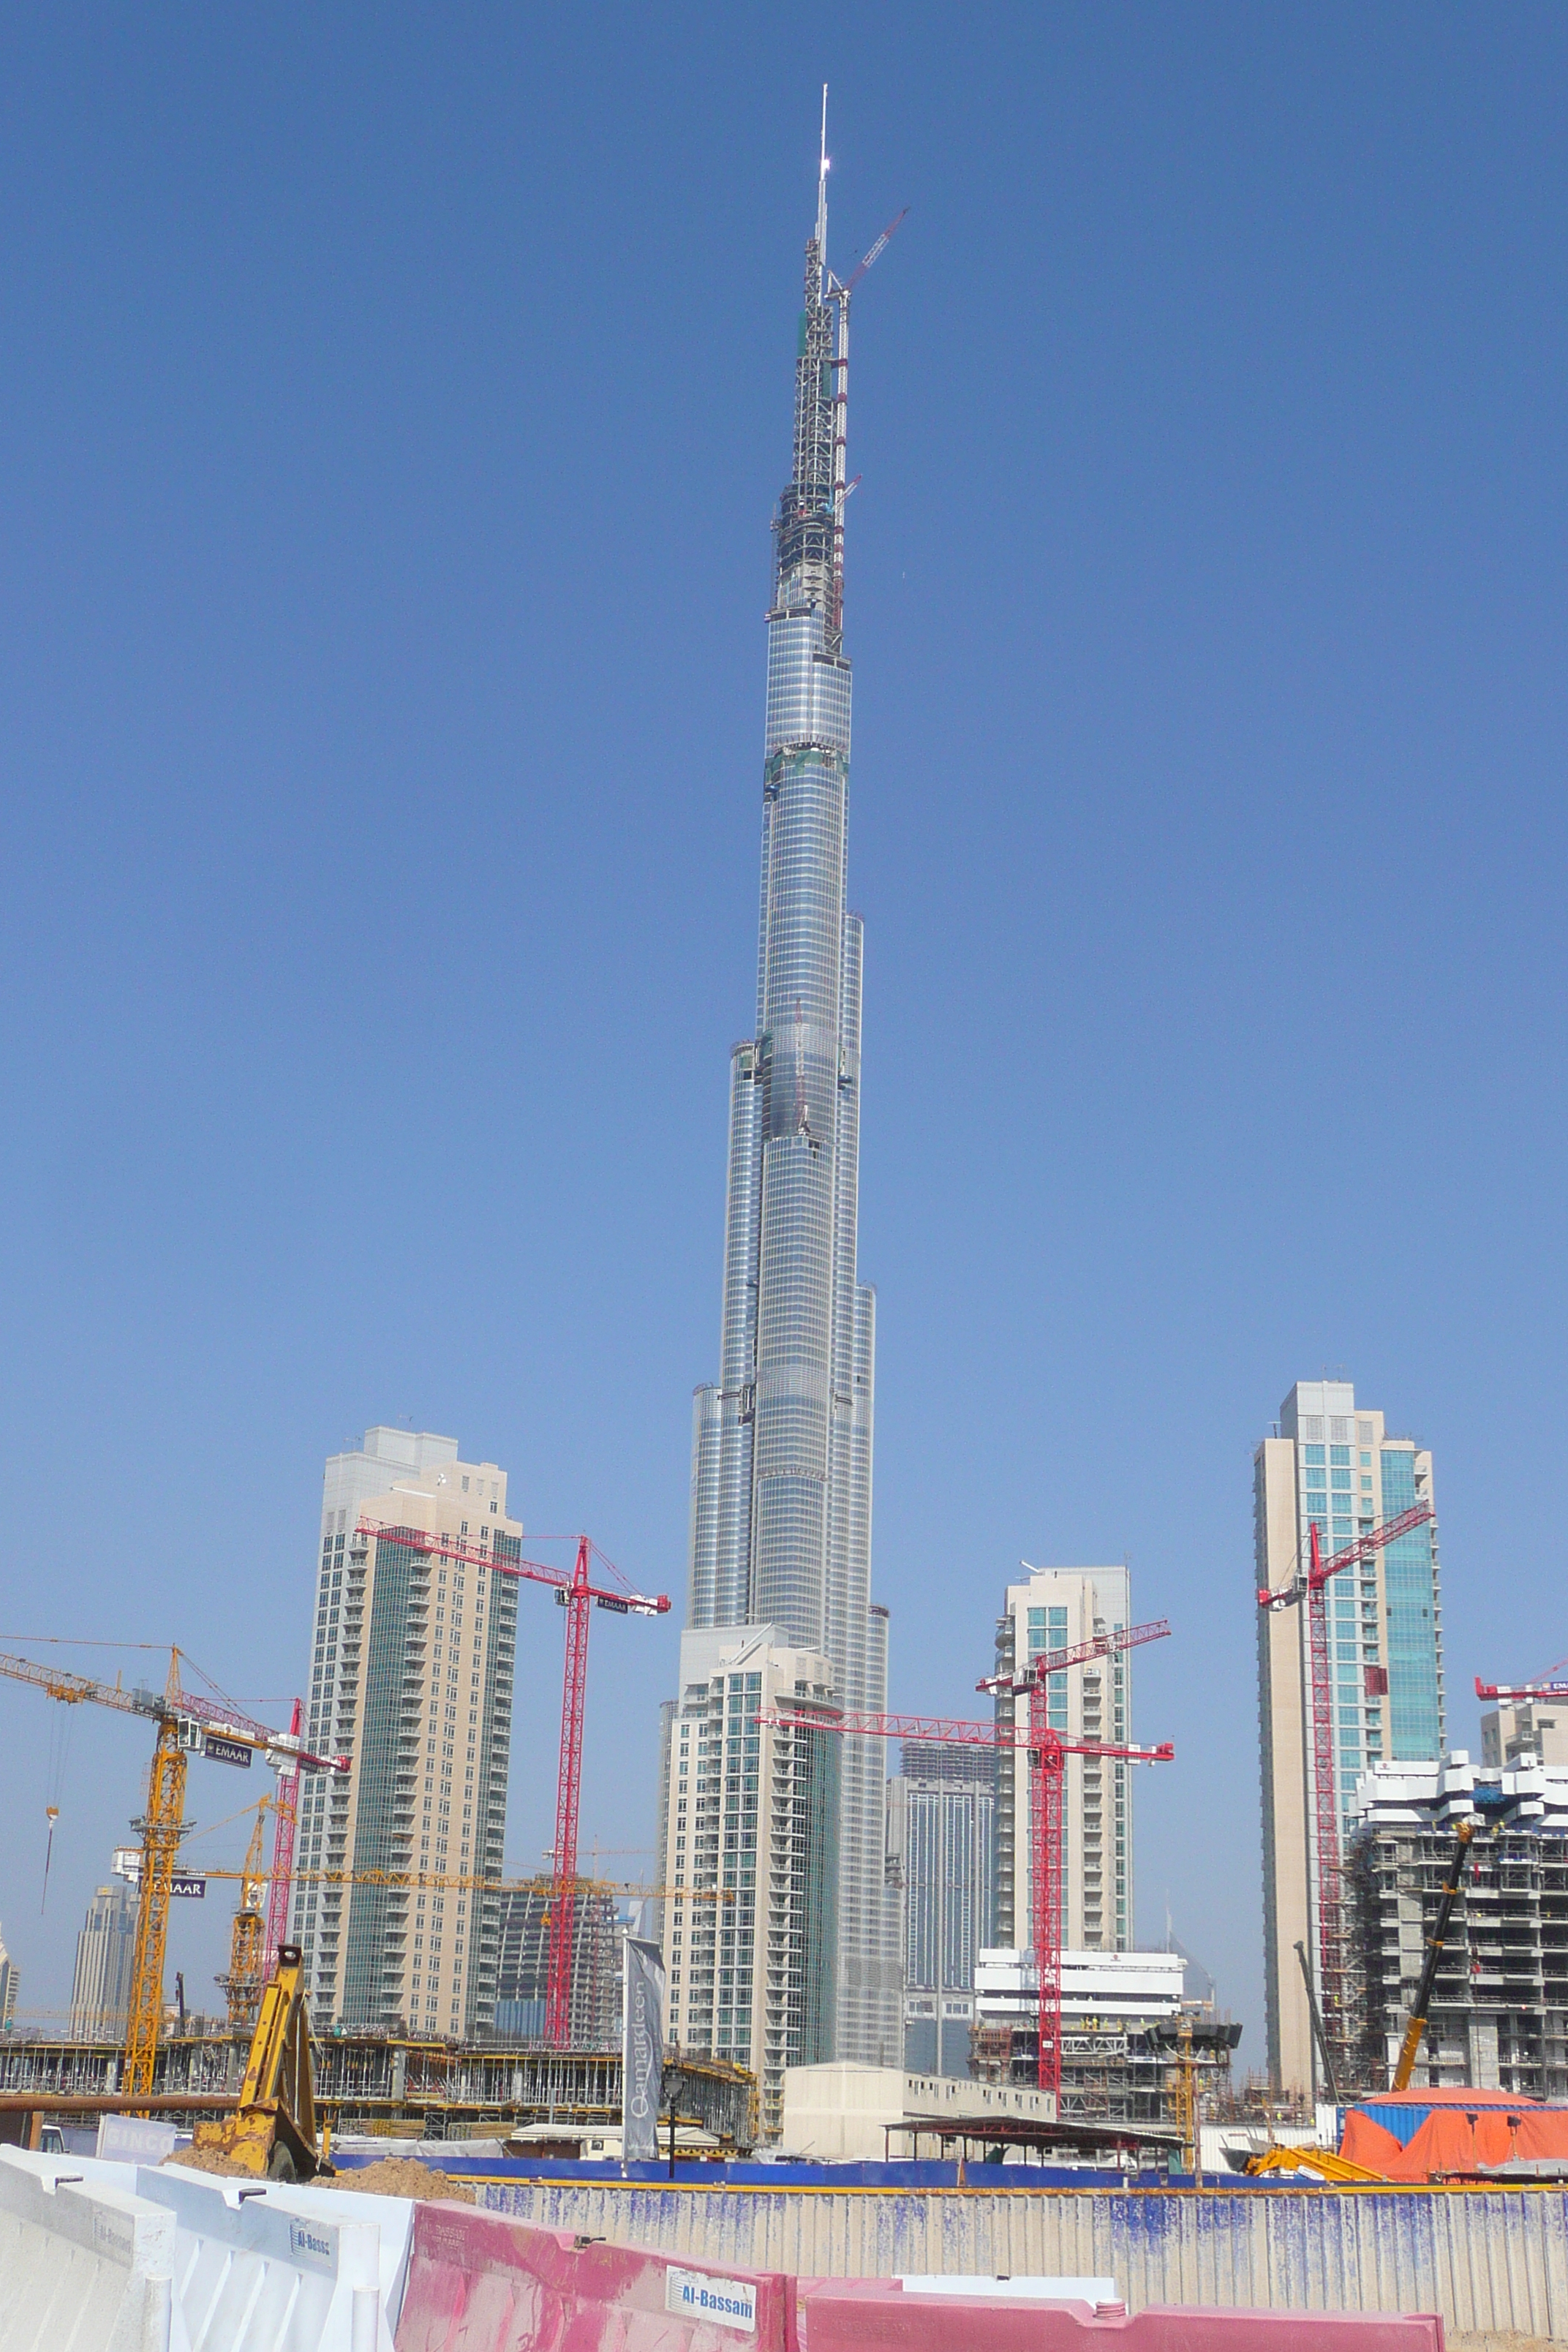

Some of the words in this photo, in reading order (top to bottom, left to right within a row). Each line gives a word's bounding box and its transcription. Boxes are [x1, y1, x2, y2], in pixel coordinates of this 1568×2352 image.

[215, 1744, 249, 1763] EMAAR
[631, 1981, 651, 2118] Qamardeen
[682, 2285, 752, 2318] Al-Bassam
